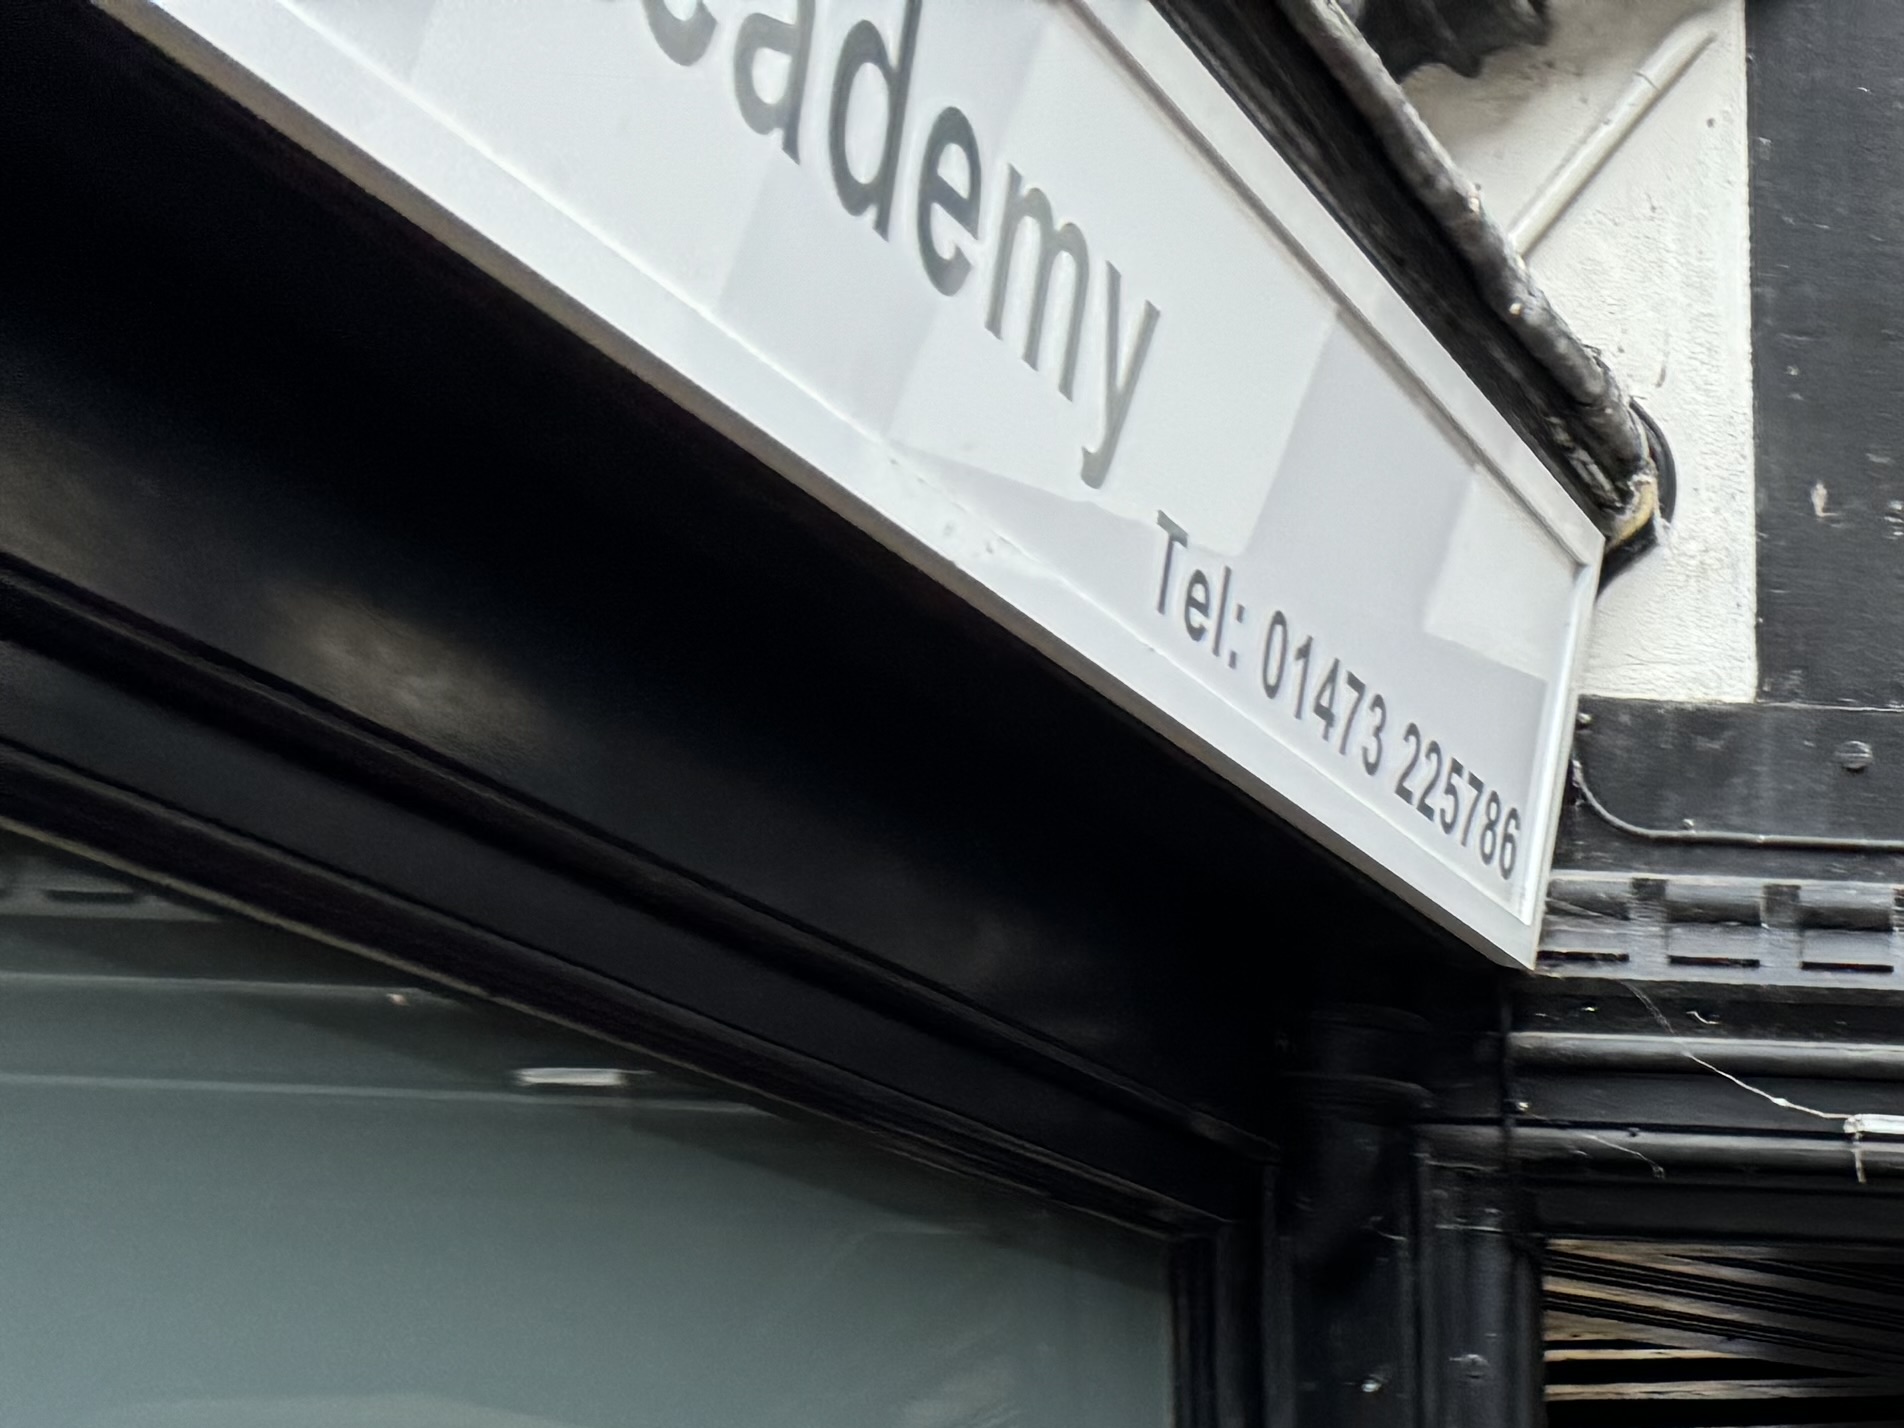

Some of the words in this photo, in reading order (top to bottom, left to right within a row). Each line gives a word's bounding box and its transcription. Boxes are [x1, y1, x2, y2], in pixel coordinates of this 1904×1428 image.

[1154, 510, 1246, 669] Tel:
[1261, 611, 1388, 777] 01473
[1394, 722, 1523, 881] 225786
